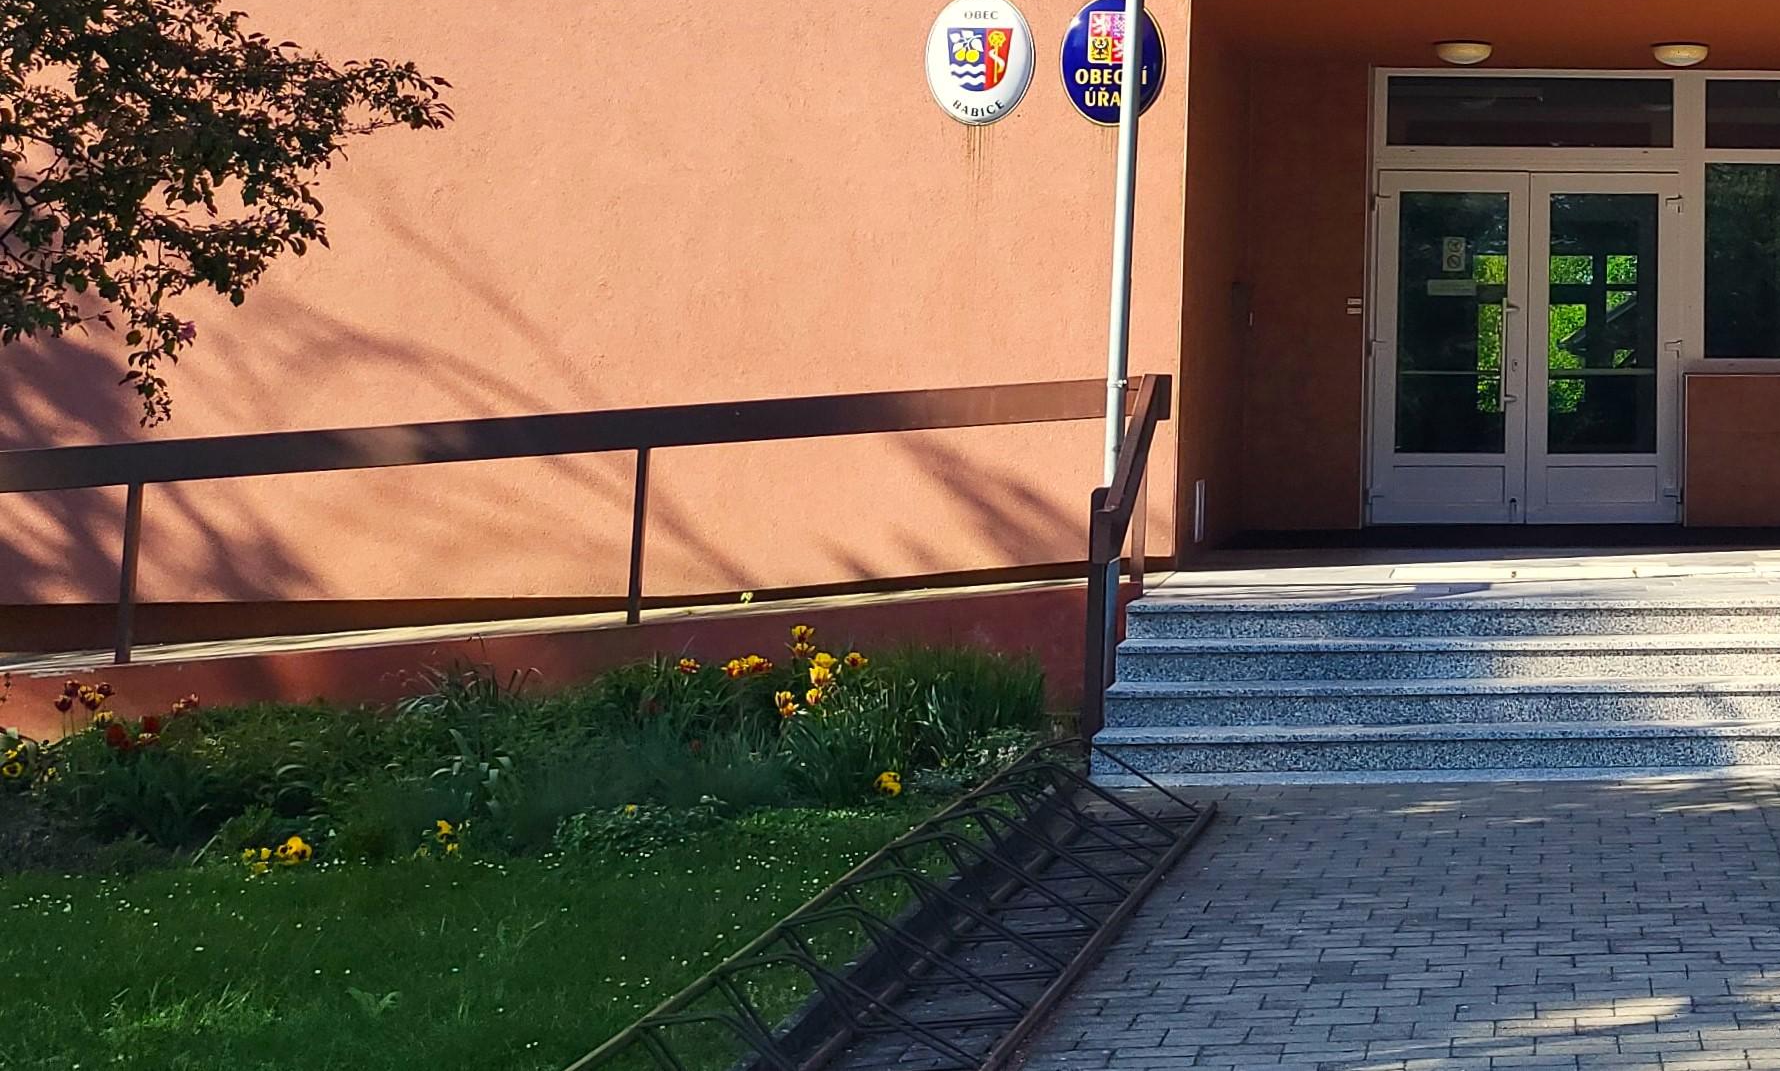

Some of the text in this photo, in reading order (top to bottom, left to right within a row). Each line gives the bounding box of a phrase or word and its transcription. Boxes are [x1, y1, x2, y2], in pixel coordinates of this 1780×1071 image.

[964, 10, 999, 20] OBEC
[1075, 65, 1148, 85] OBECÍ
[1084, 86, 1122, 107] ÚŘA
[952, 99, 1005, 117] BABICE
